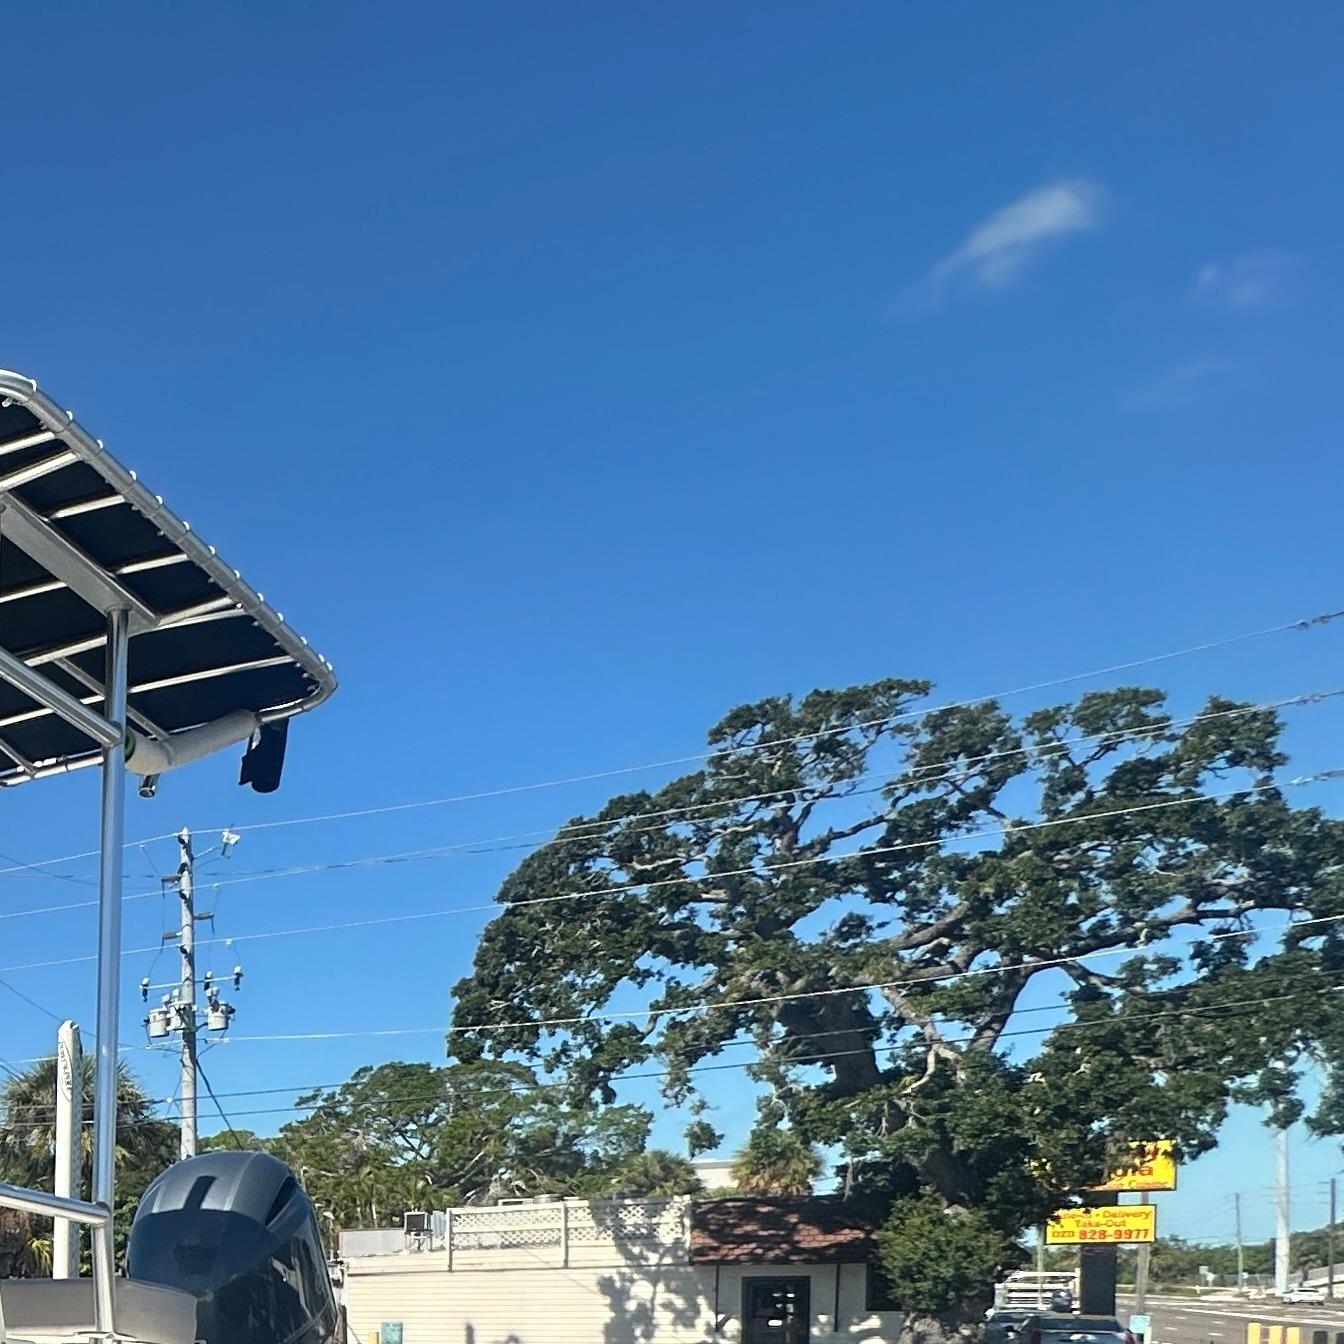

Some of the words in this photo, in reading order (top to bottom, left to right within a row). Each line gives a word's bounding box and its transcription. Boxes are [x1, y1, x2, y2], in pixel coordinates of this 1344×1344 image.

[1102, 1210, 1151, 1220] Delivery
[1074, 1219, 1127, 1228] Take-Out
[1078, 1228, 1150, 1240] 828-9977
